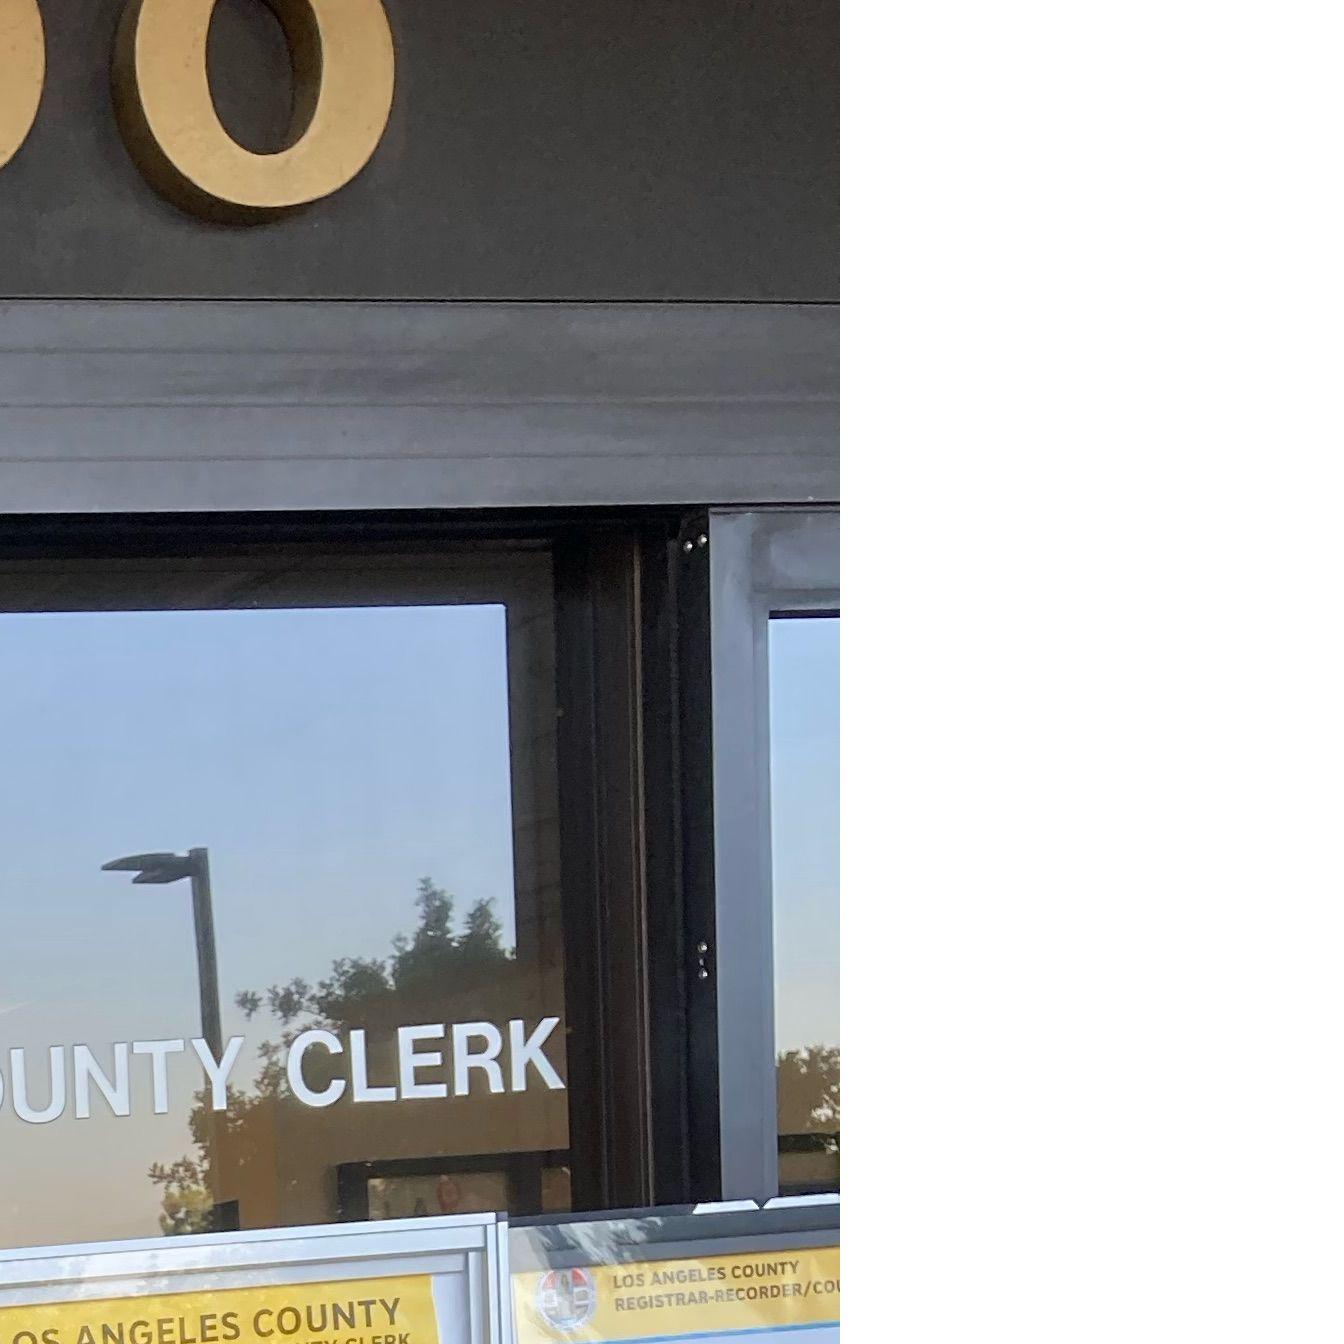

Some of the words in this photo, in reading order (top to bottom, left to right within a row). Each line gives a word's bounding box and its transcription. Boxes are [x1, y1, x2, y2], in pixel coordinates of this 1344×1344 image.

[287, 1016, 565, 1107] CLERK
[612, 1273, 643, 1288] LOS
[653, 1266, 726, 1284] ANGELES
[730, 1259, 799, 1279] COUNTY
[252, 1297, 400, 1337] COUNTY
